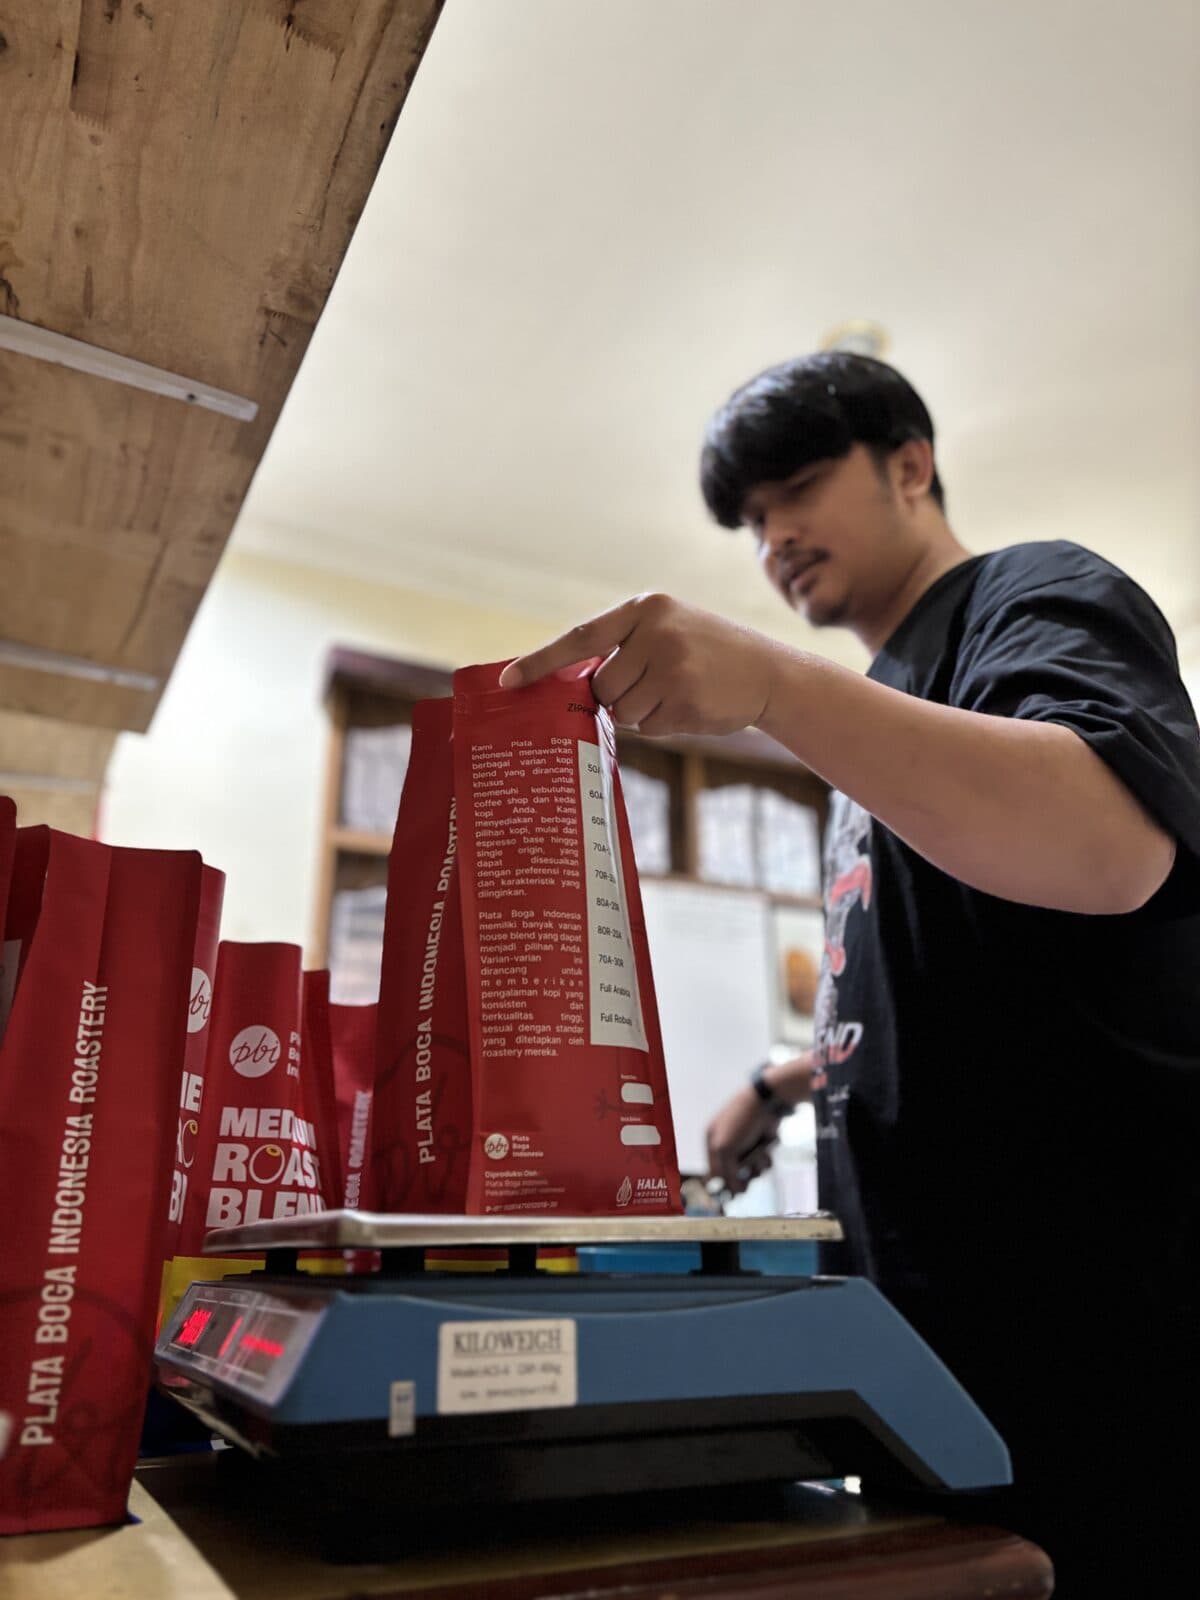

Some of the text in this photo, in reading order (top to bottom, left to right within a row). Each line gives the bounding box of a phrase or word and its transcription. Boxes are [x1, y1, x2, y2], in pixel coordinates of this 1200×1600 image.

[472, 744, 493, 752] Kami
[472, 751, 512, 760] Indonesia
[472, 760, 510, 770] berbagai
[520, 758, 546, 766] varian
[473, 766, 574, 778] blend yang dirancang
[473, 779, 504, 787] khusus
[473, 786, 575, 798] memenuhi kebutuhan
[474, 798, 502, 808] coffee
[507, 797, 528, 806] shop
[475, 809, 493, 818] kopi
[557, 806, 576, 814] Kami
[475, 816, 577, 827] menyediakan berbagai
[476, 828, 504, 838] pilihan
[563, 827, 577, 835] dari
[476, 838, 516, 847] espresso
[551, 836, 578, 845] hingga
[477, 849, 503, 858] single
[560, 847, 578, 857] yang
[477, 856, 578, 867] dapat disesuaikan
[477, 867, 579, 878] dengan preferensi rasa
[477, 877, 580, 889] dan karakteristik yang
[478, 889, 527, 898] diinginkan.
[479, 910, 581, 920] Plata Boga Indonesia
[479, 921, 582, 930] memiliki banyak varian
[480, 932, 582, 943] house blend yang dapat
[480, 944, 516, 952] menjadi
[525, 943, 553, 952] pilihan
[481, 955, 541, 964] Varian-varian
[598, 954, 624, 968] 70A-30R
[481, 966, 583, 975] dirancang untuk
[600, 983, 612, 992] Full
[482, 988, 583, 1000] pengalaman kopi yang
[482, 1001, 583, 1010] konsisten dan
[482, 1013, 533, 1021] berkualitas
[600, 1013, 613, 1022] Full
[483, 1025, 512, 1033] sesuai
[518, 1024, 551, 1033] dengan
[483, 1037, 505, 1047] yang
[516, 1036, 561, 1045] ditetapkan
[415, 1018, 433, 1083] BOGA
[483, 1048, 558, 1058] roastery mereka.
[415, 1090, 436, 1164] PLATA
[636, 1178, 668, 1189] HALAL
[20, 980, 109, 1447] PLATA BOGA INDONESIA ROASTERY
[453, 1328, 561, 1353] KILOWEIGH
